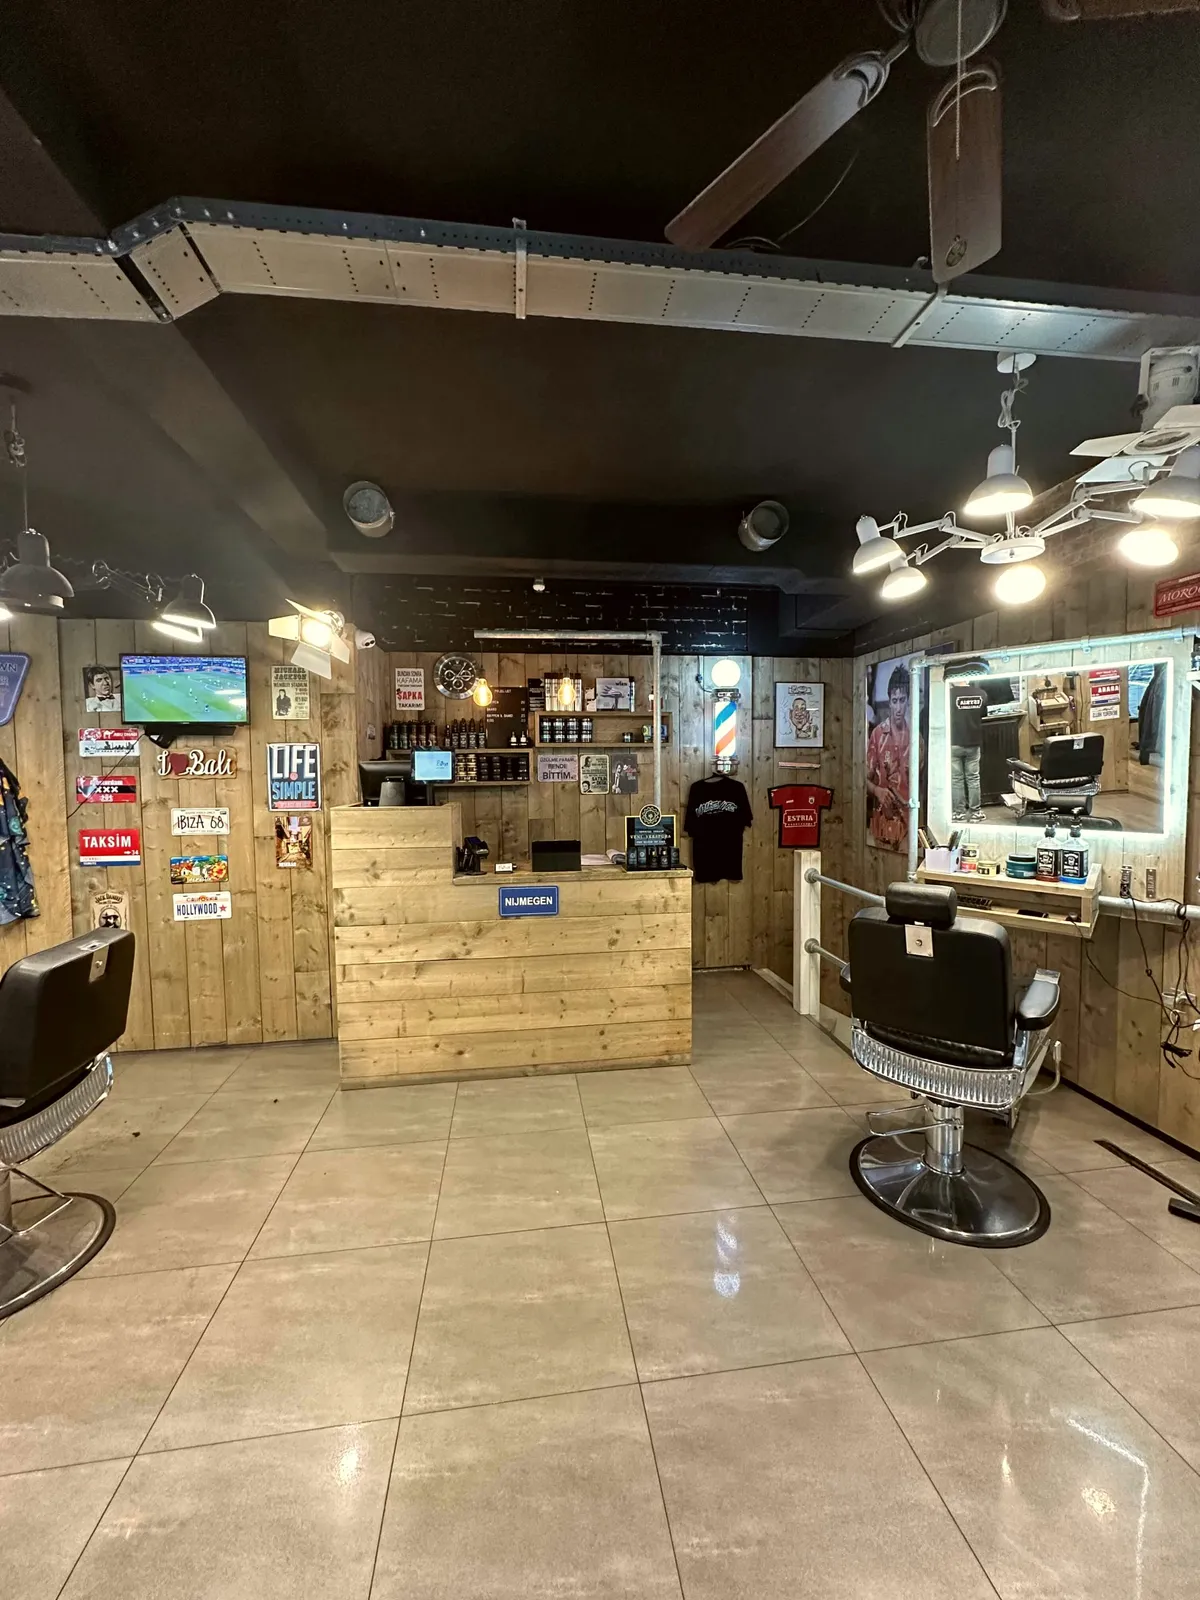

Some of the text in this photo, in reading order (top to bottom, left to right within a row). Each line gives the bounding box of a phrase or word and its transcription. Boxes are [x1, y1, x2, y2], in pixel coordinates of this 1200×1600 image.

[1158, 585, 1200, 604] MORO
[178, 749, 234, 776] Bali
[271, 745, 317, 779] LIFE
[271, 780, 316, 800] SIMPLE
[177, 814, 225, 830] IBIZA 68
[787, 814, 814, 822] ESTRIA
[176, 902, 218, 916] HOLLYWOOD
[504, 896, 554, 907] NIJMEGEN
